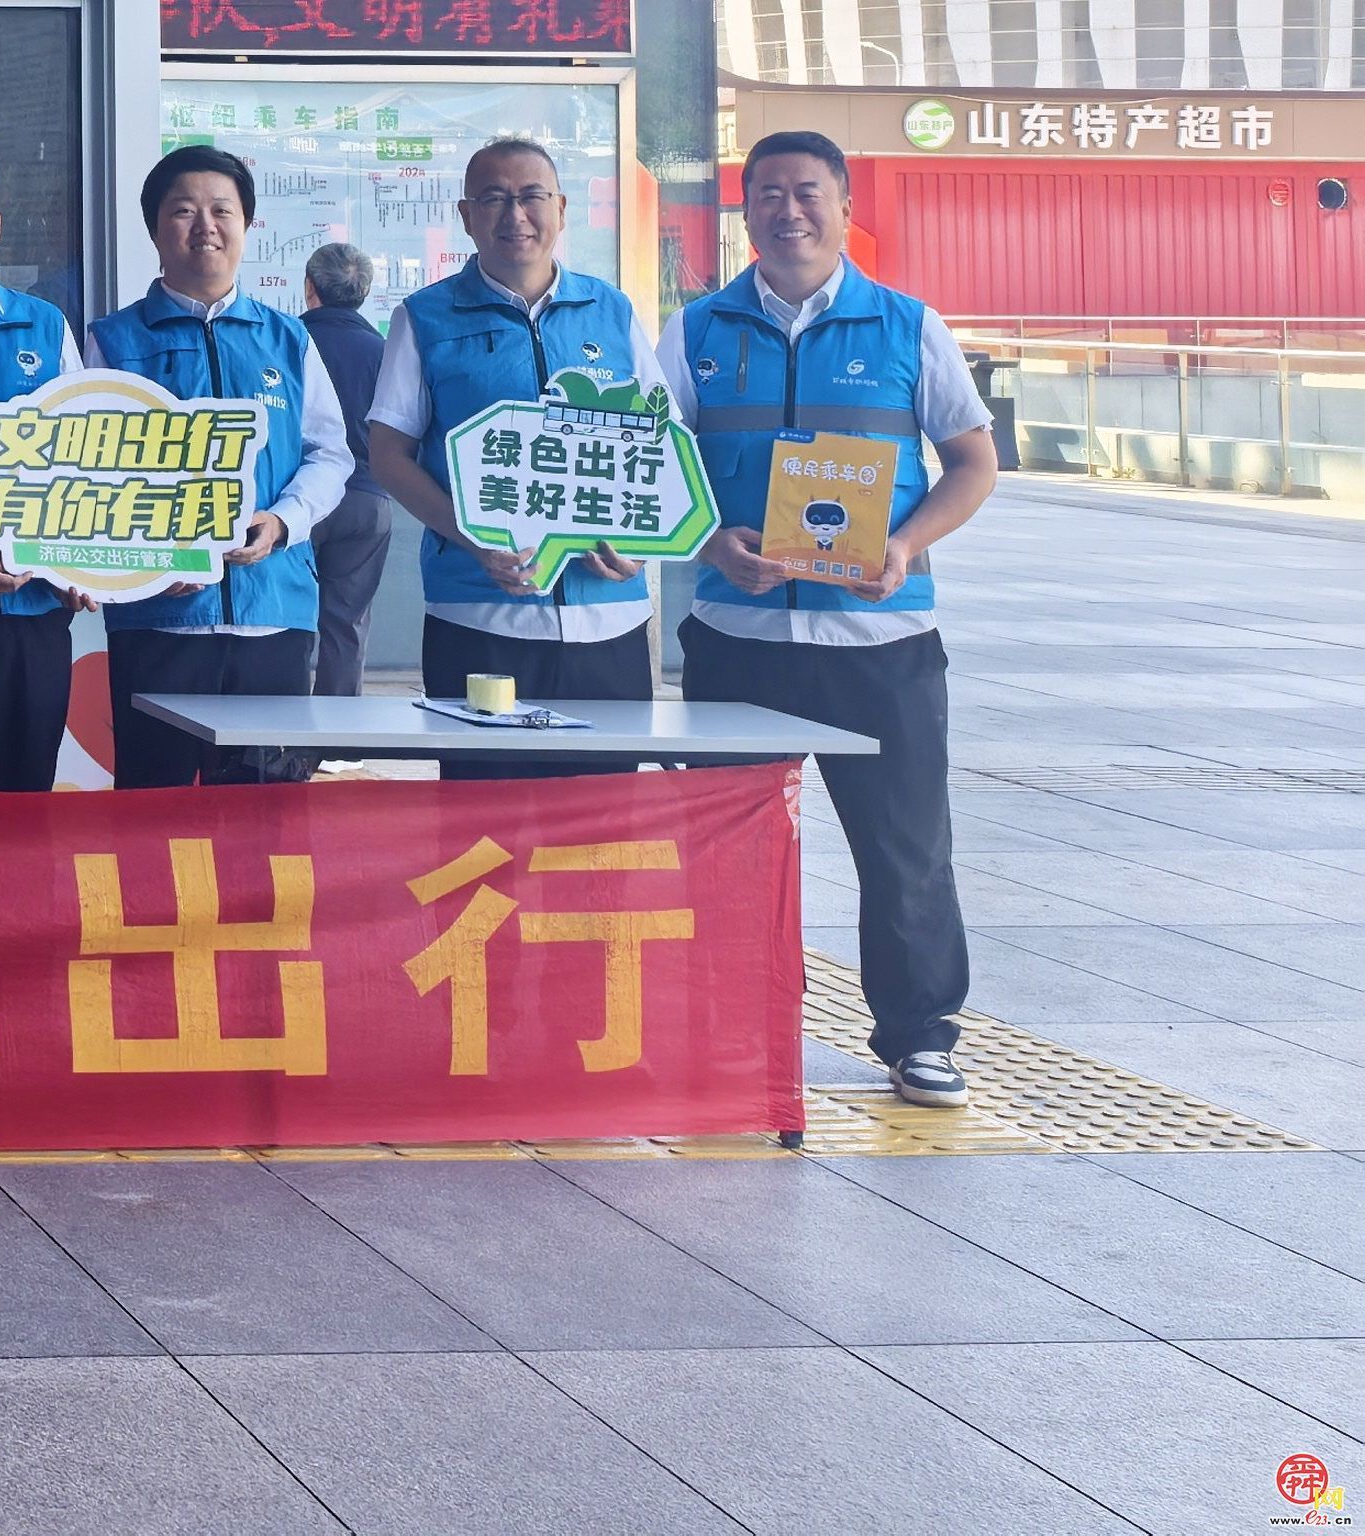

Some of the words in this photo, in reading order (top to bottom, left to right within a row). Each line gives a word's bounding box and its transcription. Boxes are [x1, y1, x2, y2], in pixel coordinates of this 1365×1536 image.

[906, 118, 954, 131] 山东特产
[967, 103, 1274, 151] 山东特产超市
[480, 428, 666, 486] 绿色出行
[477, 474, 663, 532] 美好生活
[38, 545, 175, 568] 济南公交出行管家
